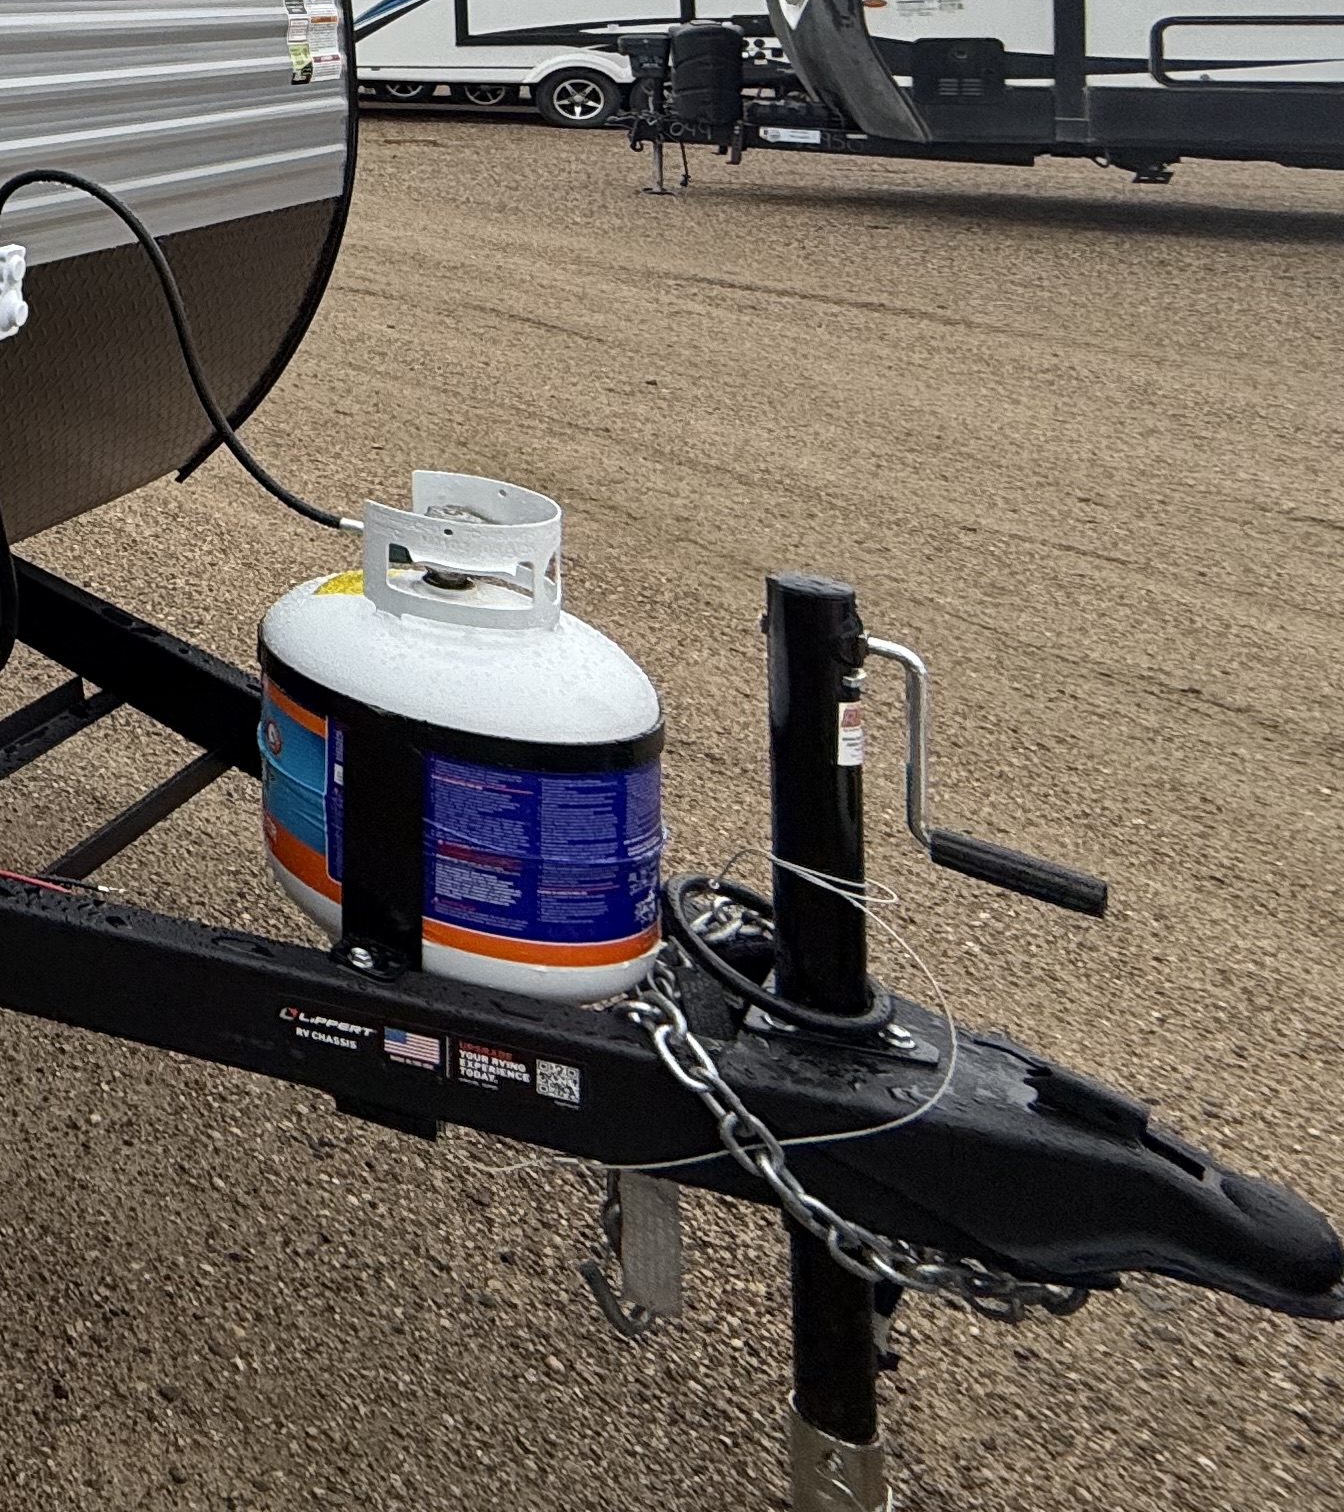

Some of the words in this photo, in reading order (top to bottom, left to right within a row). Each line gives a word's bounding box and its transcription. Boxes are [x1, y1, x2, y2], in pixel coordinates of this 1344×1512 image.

[298, 1012, 377, 1037] LIPPERT
[295, 1027, 310, 1038] RV
[311, 1031, 358, 1050] CHASSIS
[459, 1049, 489, 1064] YOUR
[491, 1057, 527, 1073] RVING
[459, 1058, 531, 1084] EXPERIENCE
